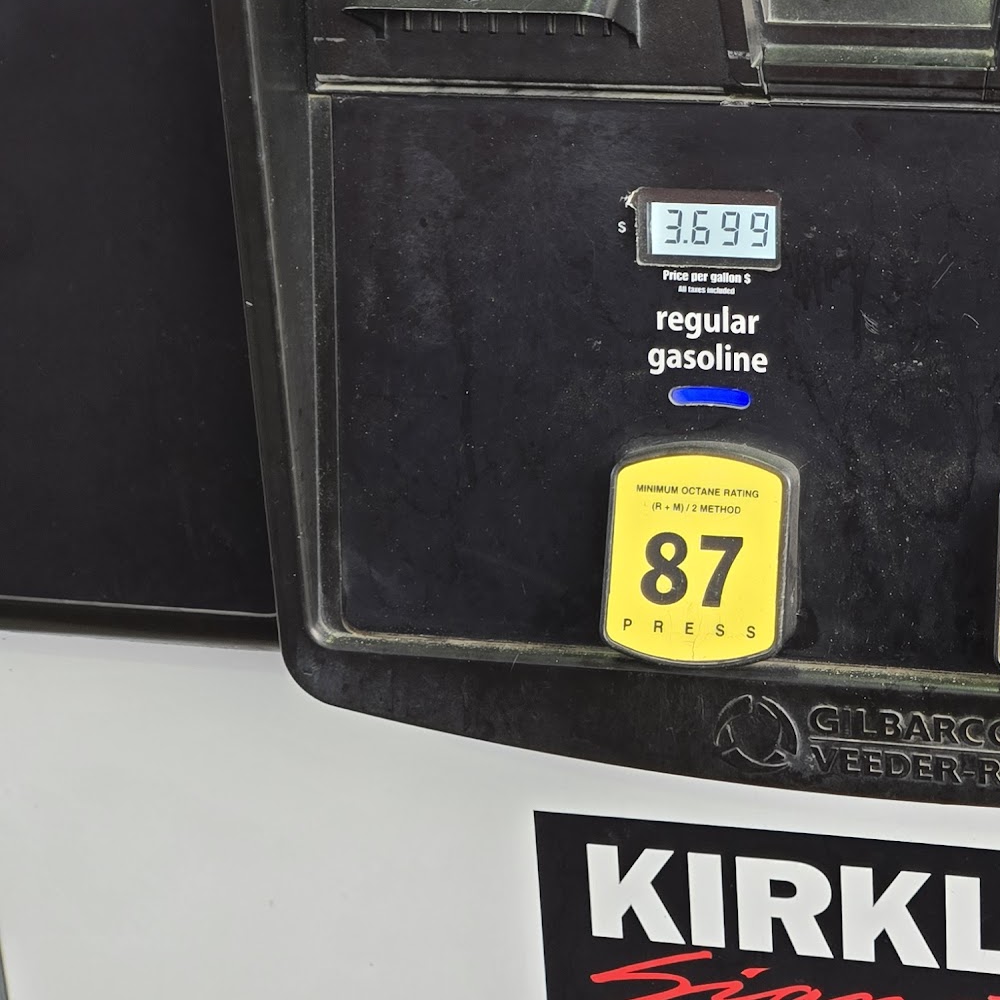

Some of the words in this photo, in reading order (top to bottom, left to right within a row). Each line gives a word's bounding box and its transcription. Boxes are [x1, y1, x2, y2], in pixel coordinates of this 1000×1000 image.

[665, 210, 769, 247] 3.699
[656, 306, 759, 339] regular
[648, 343, 768, 375] gasoline
[636, 485, 678, 494] MINIMUM
[682, 487, 720, 496] OCTANE
[724, 489, 759, 498] RATING
[640, 532, 743, 607] 87
